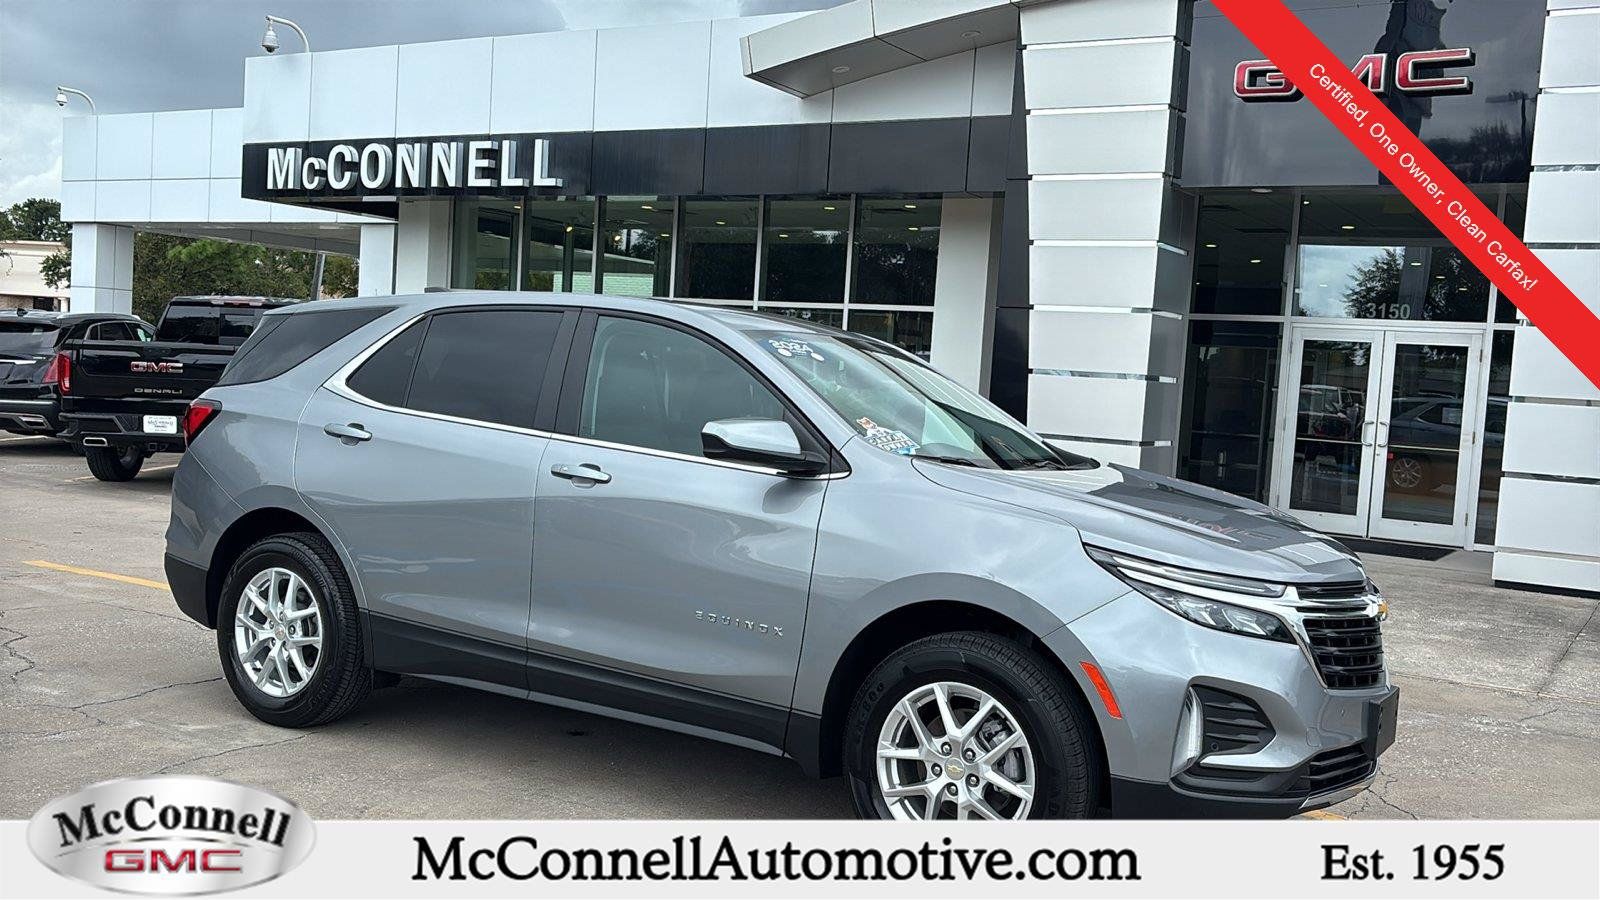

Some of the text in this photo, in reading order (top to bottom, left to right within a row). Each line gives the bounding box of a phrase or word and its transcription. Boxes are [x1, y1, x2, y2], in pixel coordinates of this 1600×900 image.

[267, 138, 563, 191] McCONNELL
[1365, 302, 1411, 319] 3150
[130, 361, 184, 374] GMC
[134, 387, 183, 395] DENALI
[695, 609, 784, 637] EQUINOX
